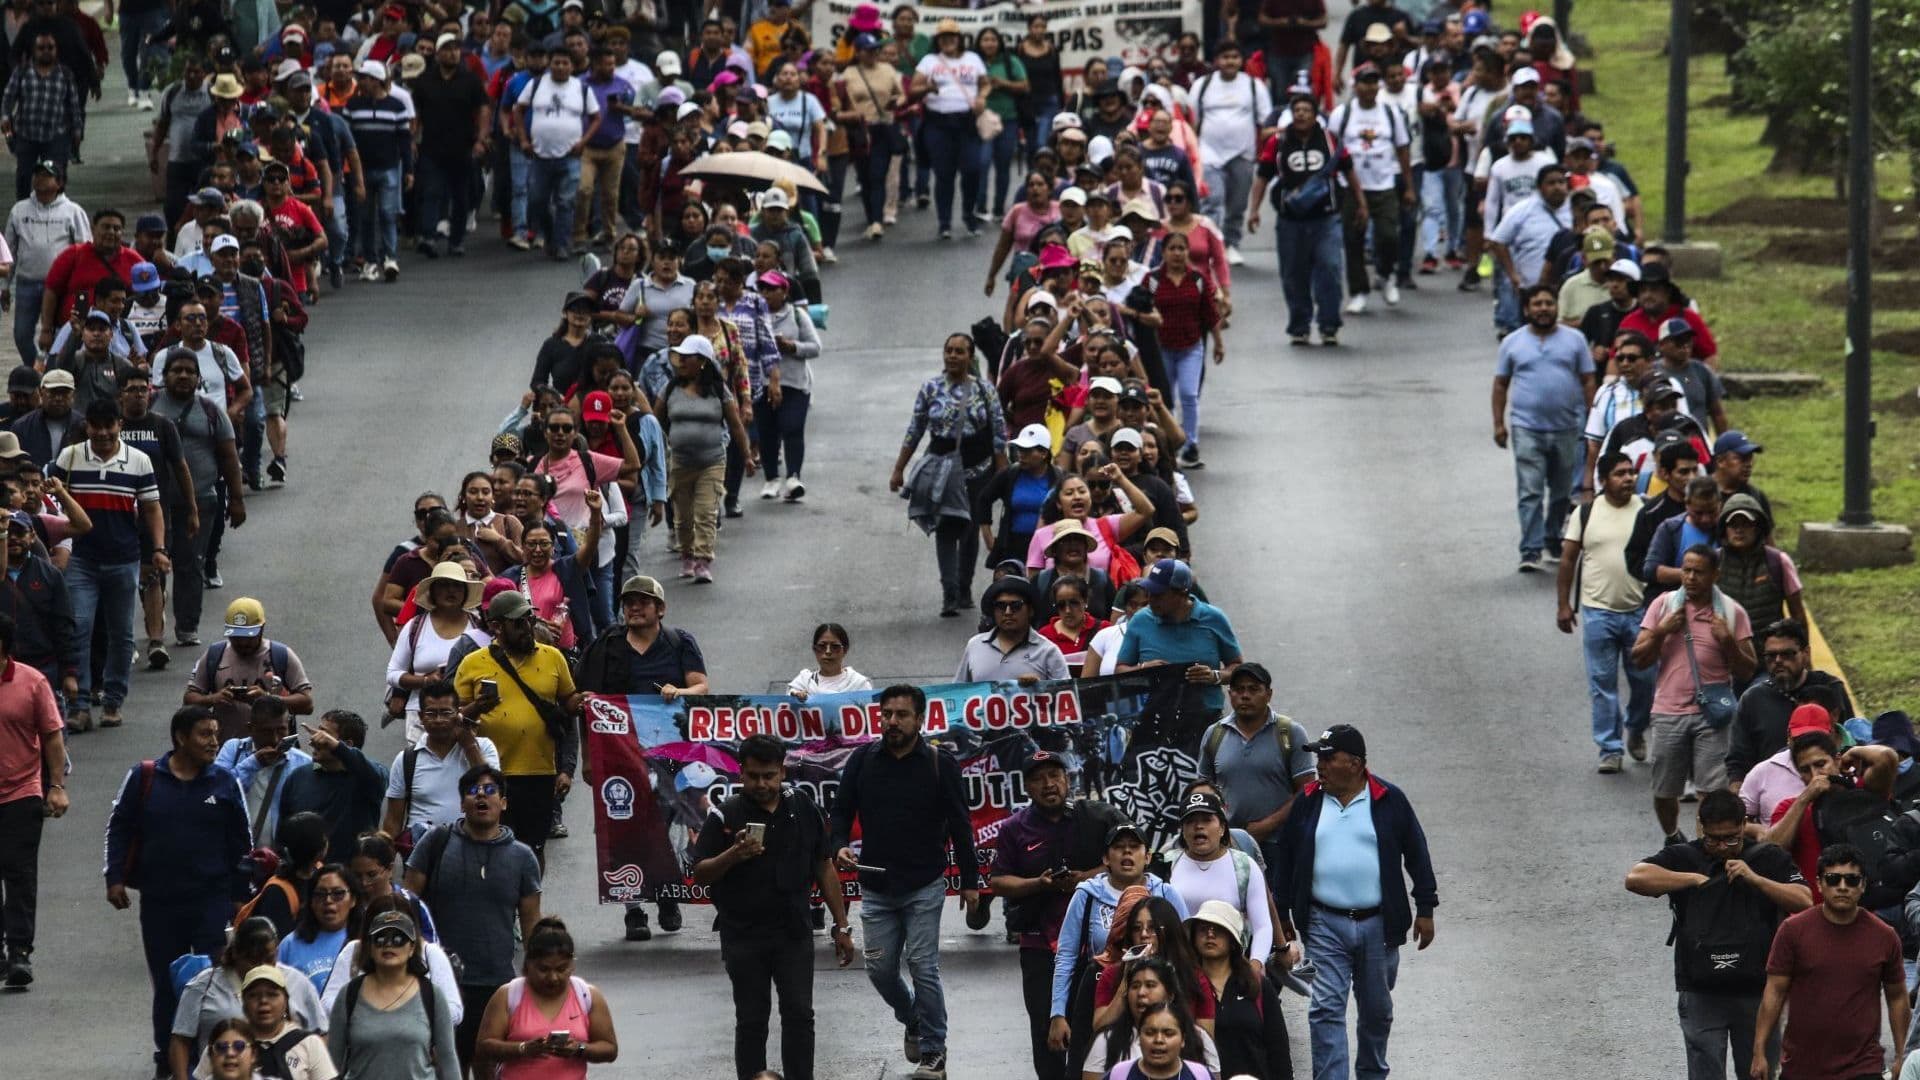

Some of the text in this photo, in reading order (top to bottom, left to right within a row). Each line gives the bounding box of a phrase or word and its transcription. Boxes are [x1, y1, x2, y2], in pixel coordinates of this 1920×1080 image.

[689, 690, 1081, 741] REGIÓN DE A COSTA
[592, 722, 628, 733] CNTE
[1710, 952, 1740, 960] Reebok
